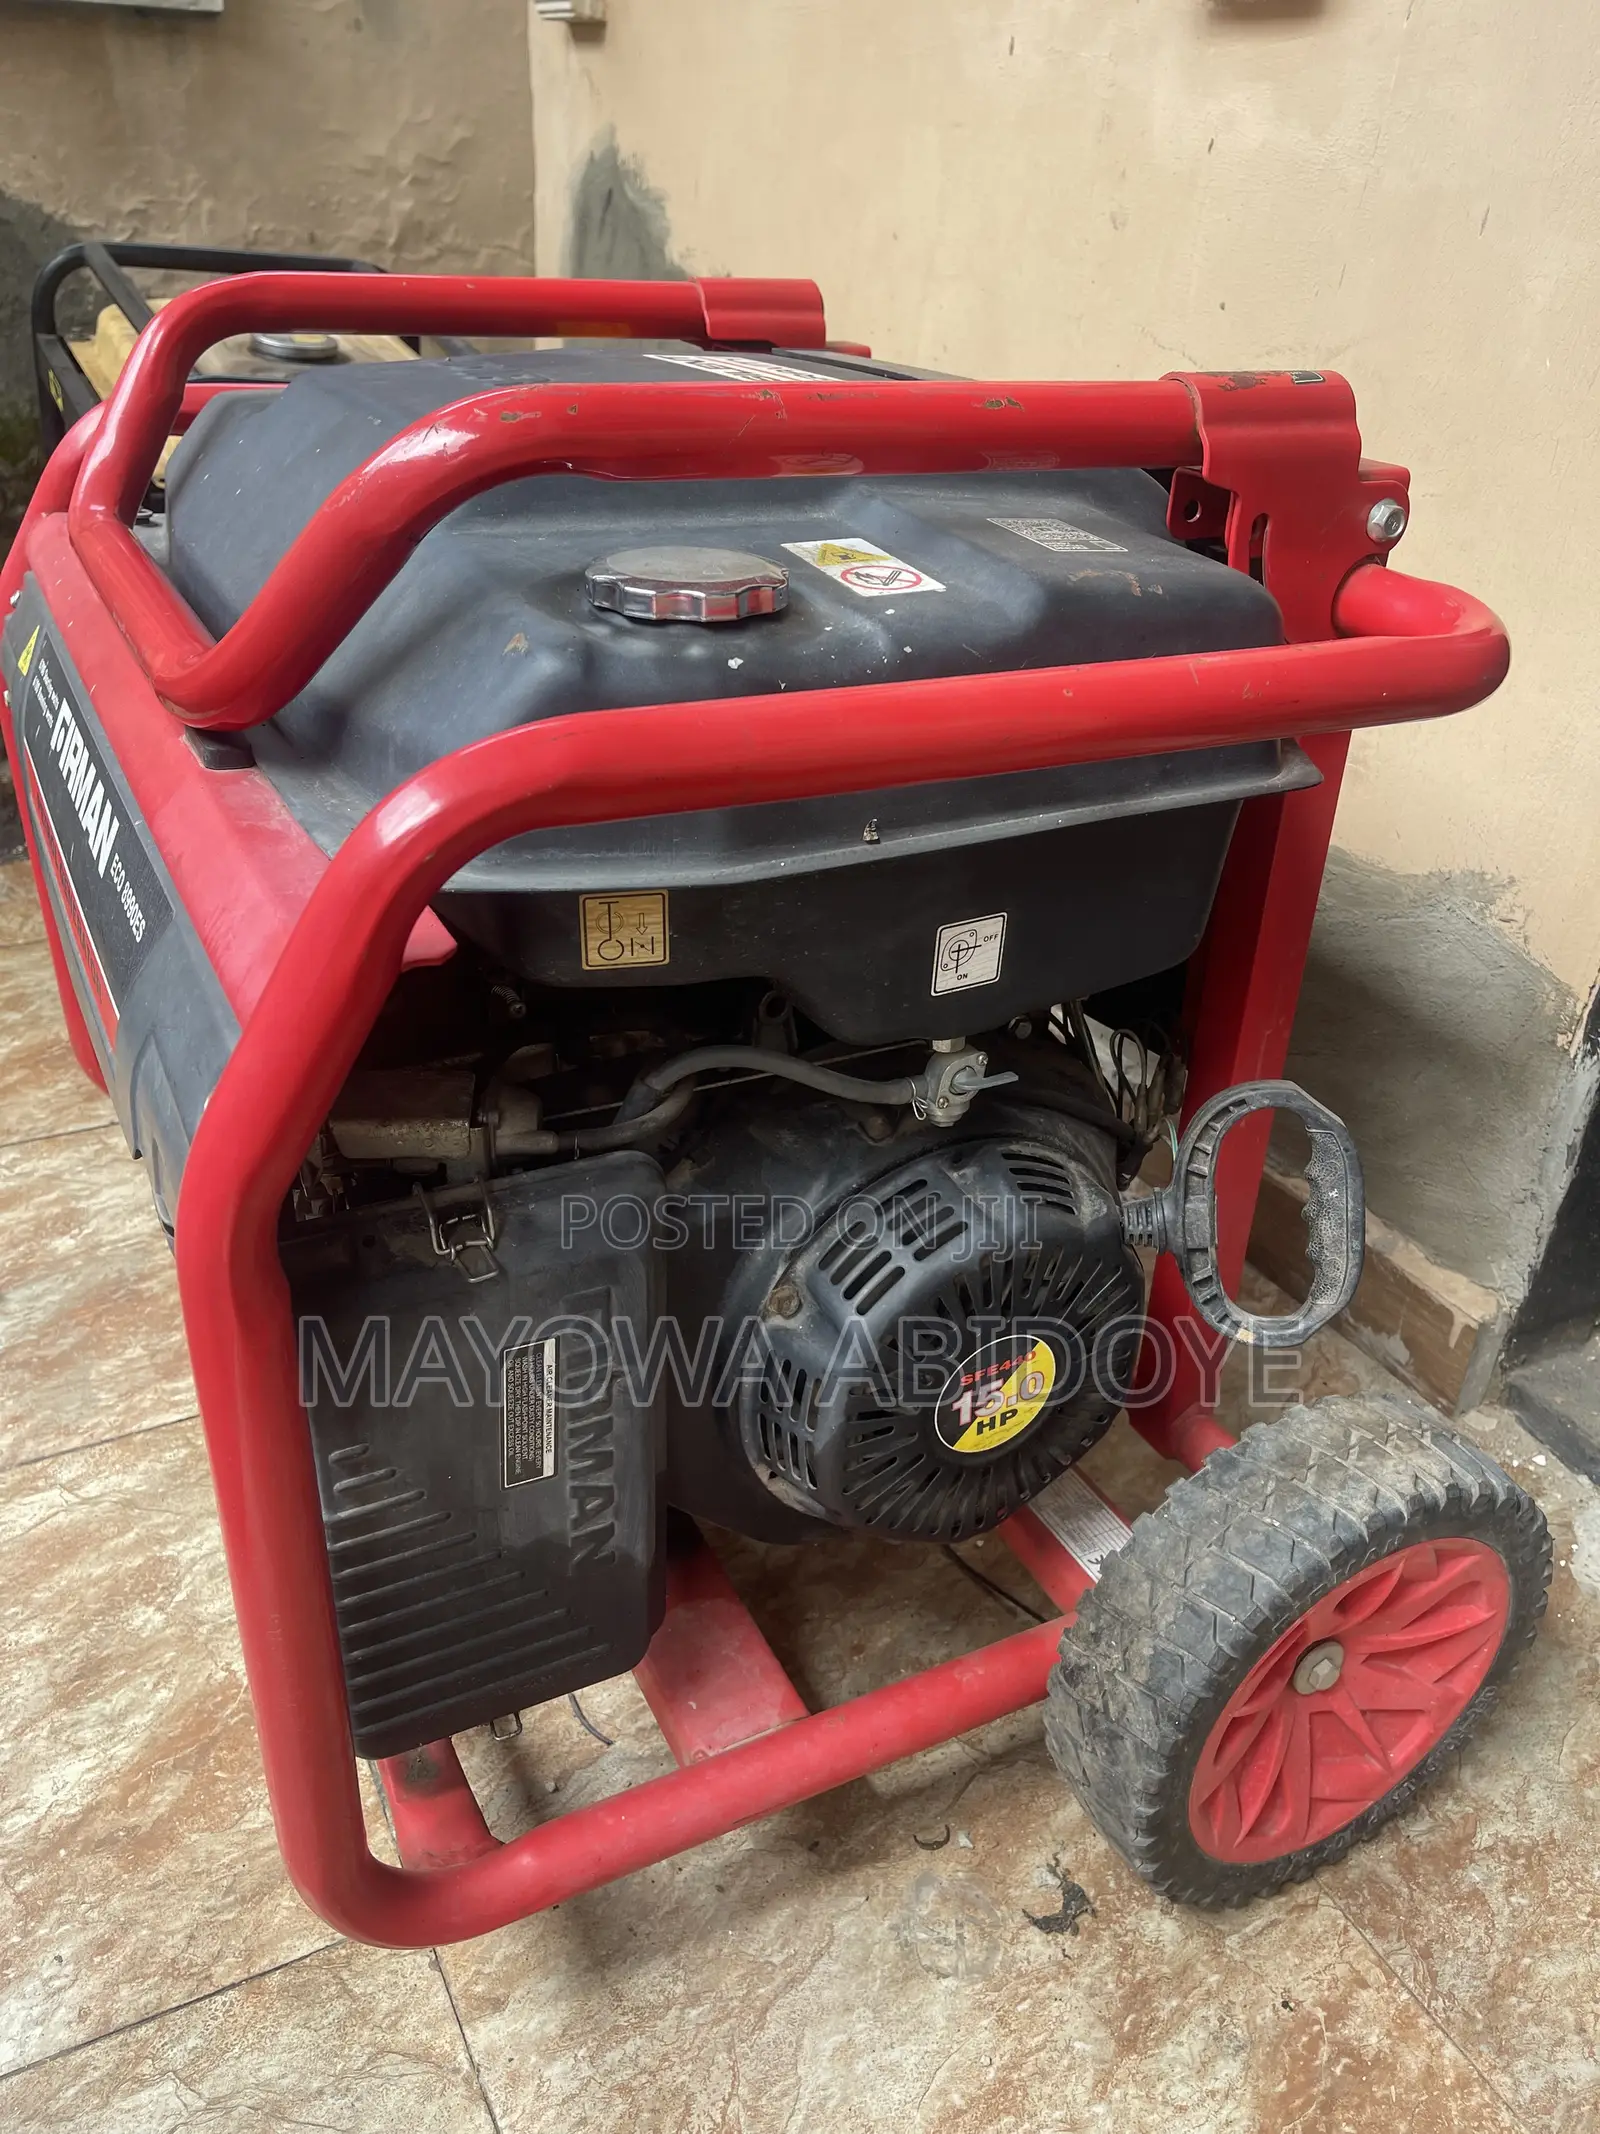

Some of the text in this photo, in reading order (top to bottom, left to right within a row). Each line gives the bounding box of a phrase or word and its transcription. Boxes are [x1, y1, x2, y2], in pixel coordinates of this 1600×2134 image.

[50, 698, 120, 879] FIRMAN
[110, 853, 146, 943] ECO 8990ES
[983, 934, 999, 942] OFF
[960, 1351, 1037, 1386] SFE440
[951, 1370, 1045, 1426] 15.0
[976, 1408, 1018, 1436] HP
